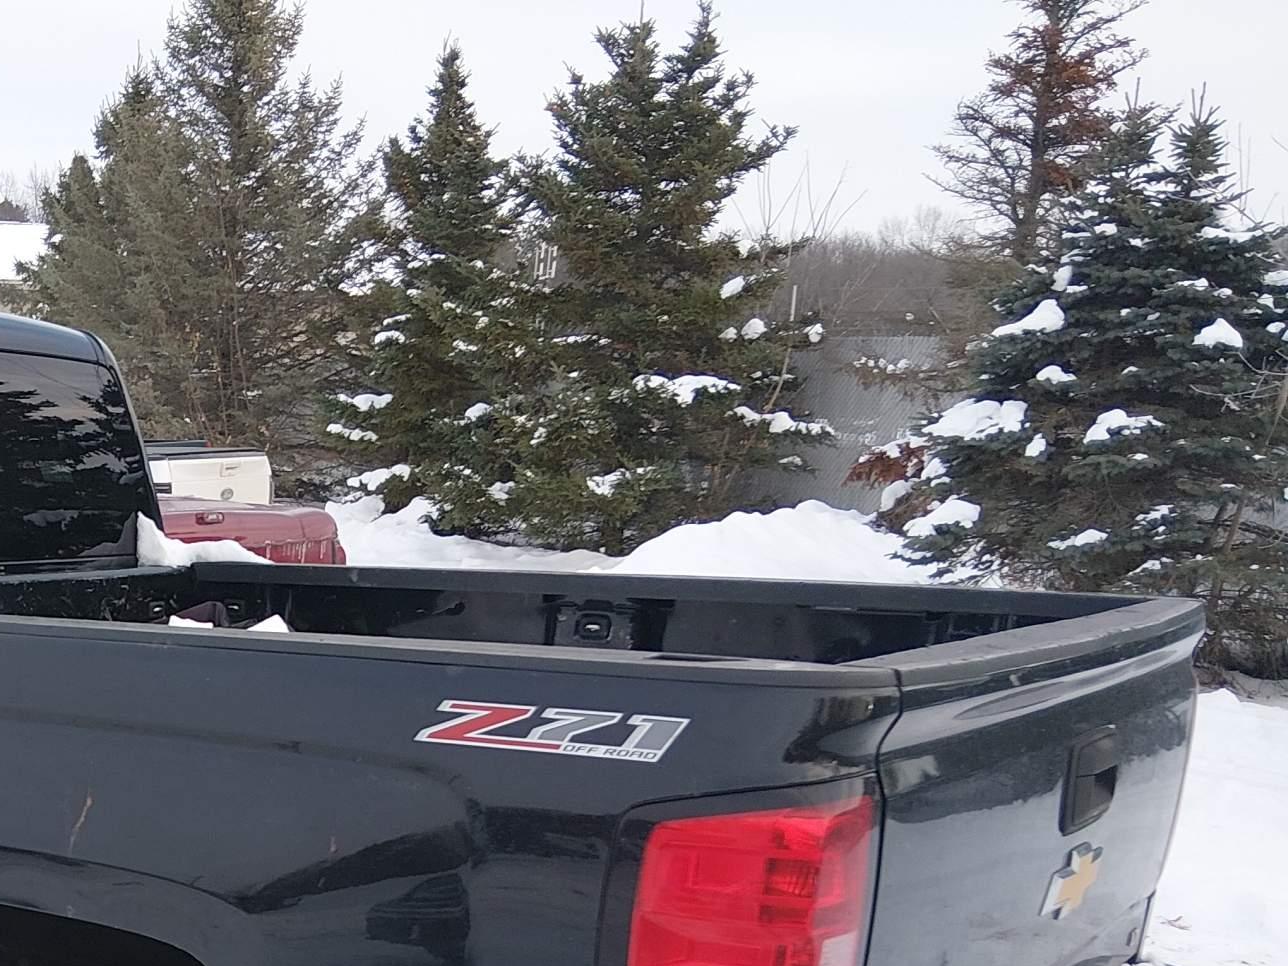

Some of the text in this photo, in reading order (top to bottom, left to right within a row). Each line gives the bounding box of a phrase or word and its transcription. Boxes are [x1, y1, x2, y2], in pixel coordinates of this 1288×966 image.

[414, 699, 692, 752] Z71
[563, 743, 658, 761] OFF ROAD
